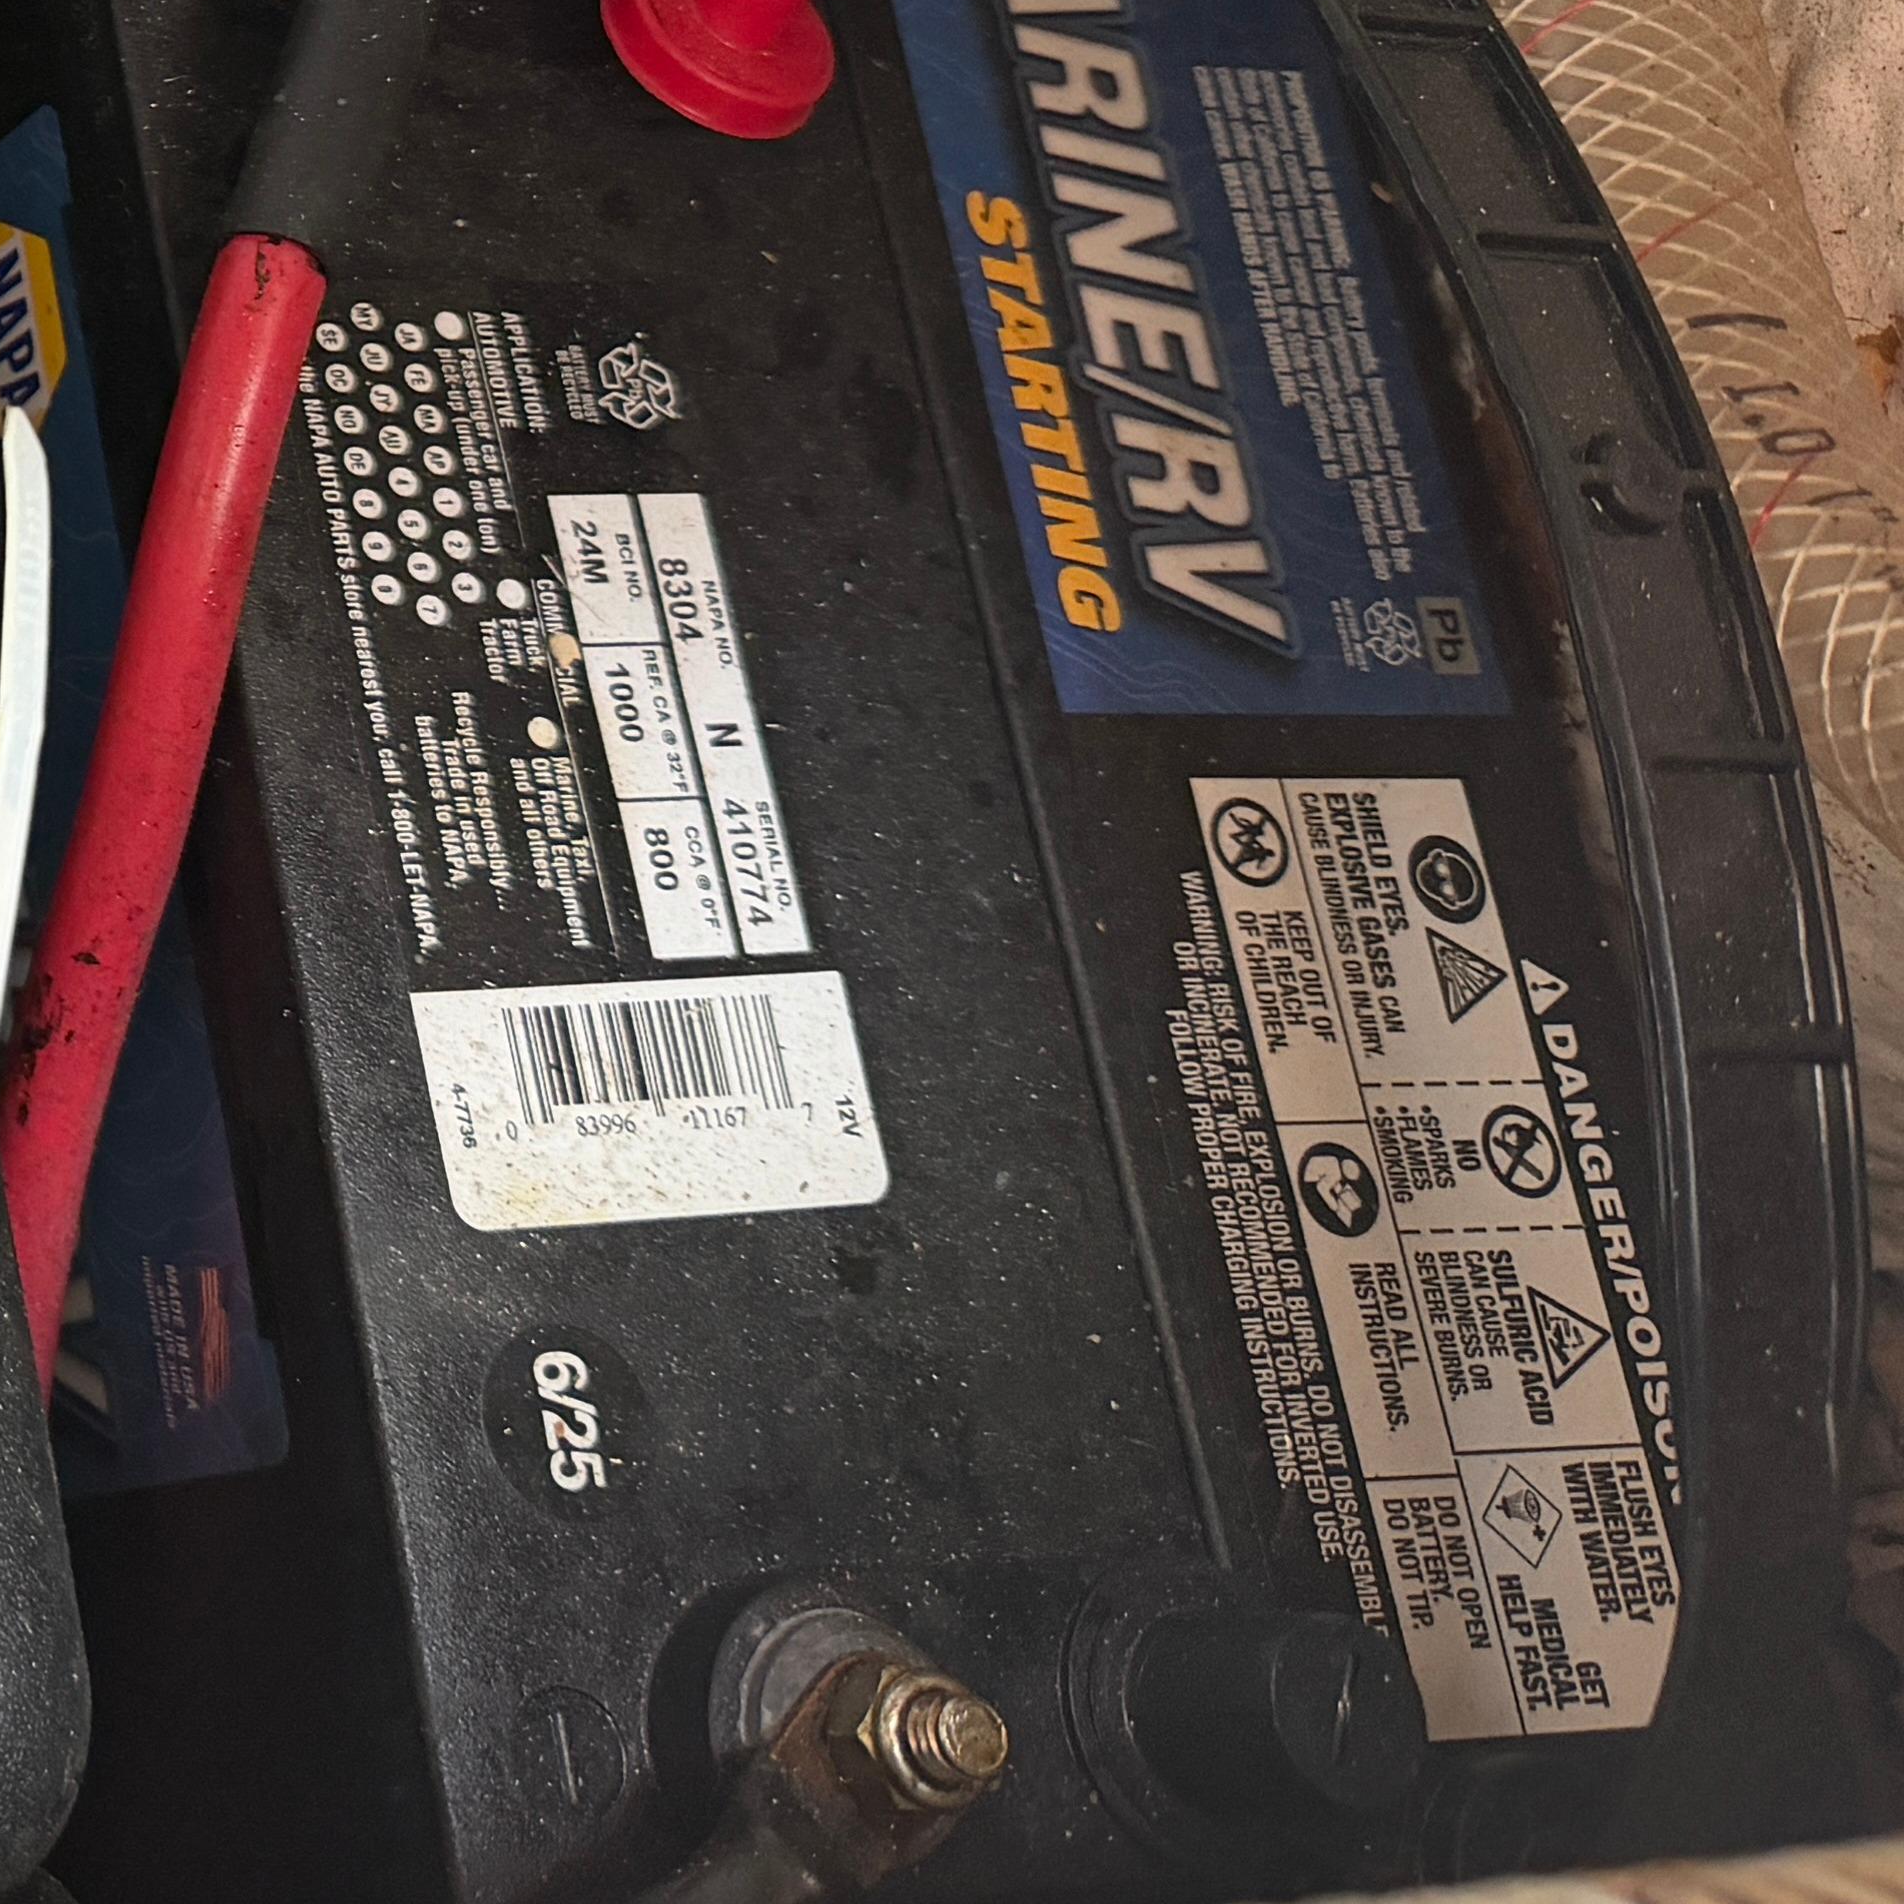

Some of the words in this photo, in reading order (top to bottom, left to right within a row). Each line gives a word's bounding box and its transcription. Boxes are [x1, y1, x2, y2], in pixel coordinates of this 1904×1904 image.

[433, 347, 469, 409] pick-up
[454, 347, 494, 439] Passenger
[471, 311, 517, 428] AUTOMOTIVE
[500, 312, 548, 433] APPLICATION:
[301, 398, 331, 447] NAPA
[962, 190, 1123, 630] STARTING
[449, 417, 484, 474] (under
[480, 444, 497, 471] car
[313, 453, 343, 501] AUTO
[468, 480, 488, 512] one
[488, 477, 511, 510] and
[325, 508, 358, 568] PARTS
[472, 517, 502, 553] ton)
[569, 519, 610, 584] 24M
[613, 533, 635, 564] BCI
[339, 574, 368, 620] store
[622, 570, 644, 602] NO.
[655, 557, 705, 642] 8304
[476, 619, 508, 683] Tractor
[497, 618, 525, 665] Farm
[533, 578, 583, 707] COMMCIAL
[700, 580, 726, 630] NAPA
[713, 637, 736, 669] NO.
[1425, 608, 1469, 663] Pb
[350, 626, 384, 696] nearest
[640, 649, 664, 689] REF.
[446, 692, 484, 765] Recycle
[602, 663, 646, 742] 1000
[651, 695, 672, 722] CA
[659, 729, 677, 745] @
[704, 722, 743, 747] N
[377, 748, 403, 783] call
[412, 715, 450, 798] batteries
[432, 805, 455, 823] to
[440, 739, 469, 788] Trade
[508, 757, 533, 792] and
[528, 757, 552, 785] Off
[453, 795, 475, 814] in
[517, 797, 540, 822] all
[535, 790, 564, 838] Road
[1296, 792, 1330, 848] CAUSE
[458, 819, 486, 864] used
[524, 828, 556, 889] others
[642, 827, 680, 891] 800
[682, 825, 706, 866] CCA
[719, 797, 775, 926] 410774
[753, 800, 784, 872] SERIAL
[772, 878, 793, 912] NO.
[1351, 793, 1393, 868] SHIELD
[1373, 876, 1411, 935] EYES.
[546, 844, 590, 947] Equipment
[693, 874, 711, 890] @
[1312, 855, 1358, 954] BLINDNESS
[1178, 871, 1226, 977] WARNING:
[1233, 911, 1260, 937] OF
[1258, 910, 1287, 949] THE
[1282, 910, 1315, 962] KEEP
[1323, 793, 1376, 908] EXPLOSIVE
[1355, 916, 1397, 988] GASES
[1376, 995, 1405, 1033] CAN
[1171, 941, 1200, 969] OR
[1339, 960, 1365, 984] OR
[1206, 982, 1240, 1032] RISK
[1241, 943, 1289, 1053] CHILDREN.
[1270, 956, 1307, 1025] REACH
[1297, 968, 1327, 1009] OUT
[1180, 976, 1234, 1107] INCINERATE.
[1219, 1037, 1248, 1065] OF
[1309, 1015, 1336, 1043] OF
[1347, 990, 1385, 1058] INJURY.
[450, 1082, 479, 1150] 4-7736
[505, 1121, 519, 1141] 0
[576, 1115, 638, 1138] 83996
[802, 1102, 814, 1122] 7
[834, 1095, 863, 1140] 12V
[1213, 1112, 1246, 1156] NOT
[1451, 1138, 1482, 1171] NO
[1242, 1130, 1294, 1252] EXPLOSION
[1163, 1009, 1207, 1096] FOLLOW
[1186, 1101, 1230, 1189] PROPER
[1208, 1194, 1259, 1311] CHARGING
[1237, 1316, 1302, 1489] INSTRUCTIONS.
[1225, 1161, 1290, 1337] RECOMMENDED
[1273, 1257, 1303, 1289] OR
[1461, 1249, 1491, 1289] CAN
[1372, 1261, 1409, 1322] READ
[1282, 1295, 1325, 1378] BURNS.
[1347, 1262, 1411, 1432] INSTRUCTIONS.
[1389, 1327, 1421, 1369] ALL
[1412, 1250, 1450, 1324] SEVERE
[1432, 1329, 1470, 1401] BURNS.
[1436, 1250, 1484, 1358] BLINDNESS
[1466, 1362, 1493, 1391] OR
[1473, 1293, 1509, 1358] CAUSE
[1485, 1248, 1538, 1364] SULFURIC
[1517, 1366, 1555, 1427] ACID
[1269, 1341, 1302, 1387] FOR
[533, 1351, 608, 1493] 6/25
[1304, 1383, 1334, 1417] DO
[1281, 1392, 1331, 1505] INVERTED
[1314, 1425, 1347, 1468] NOT
[1381, 1496, 1410, 1531] DO
[1432, 1494, 1461, 1529] DO
[1559, 1462, 1599, 1526] WITH
[1310, 1509, 1345, 1563] USE.
[1391, 1536, 1424, 1585] NOT
[1407, 1495, 1454, 1603] BATTERY.
[1442, 1532, 1474, 1582] NOT
[1586, 1458, 1654, 1628] IMMEDIATELY
[1613, 1458, 1658, 1539] FLUSH
[1637, 1542, 1677, 1608] EYES
[1577, 1530, 1625, 1623] WATER.
[1404, 1589, 1435, 1629] TIP.
[1455, 1585, 1492, 1651] OPEN
[1494, 1571, 1535, 1640] HELP
[1512, 1642, 1553, 1711] FAST.
[1528, 1596, 1581, 1711] MEDICAL
[1574, 1659, 1610, 1712] GET
